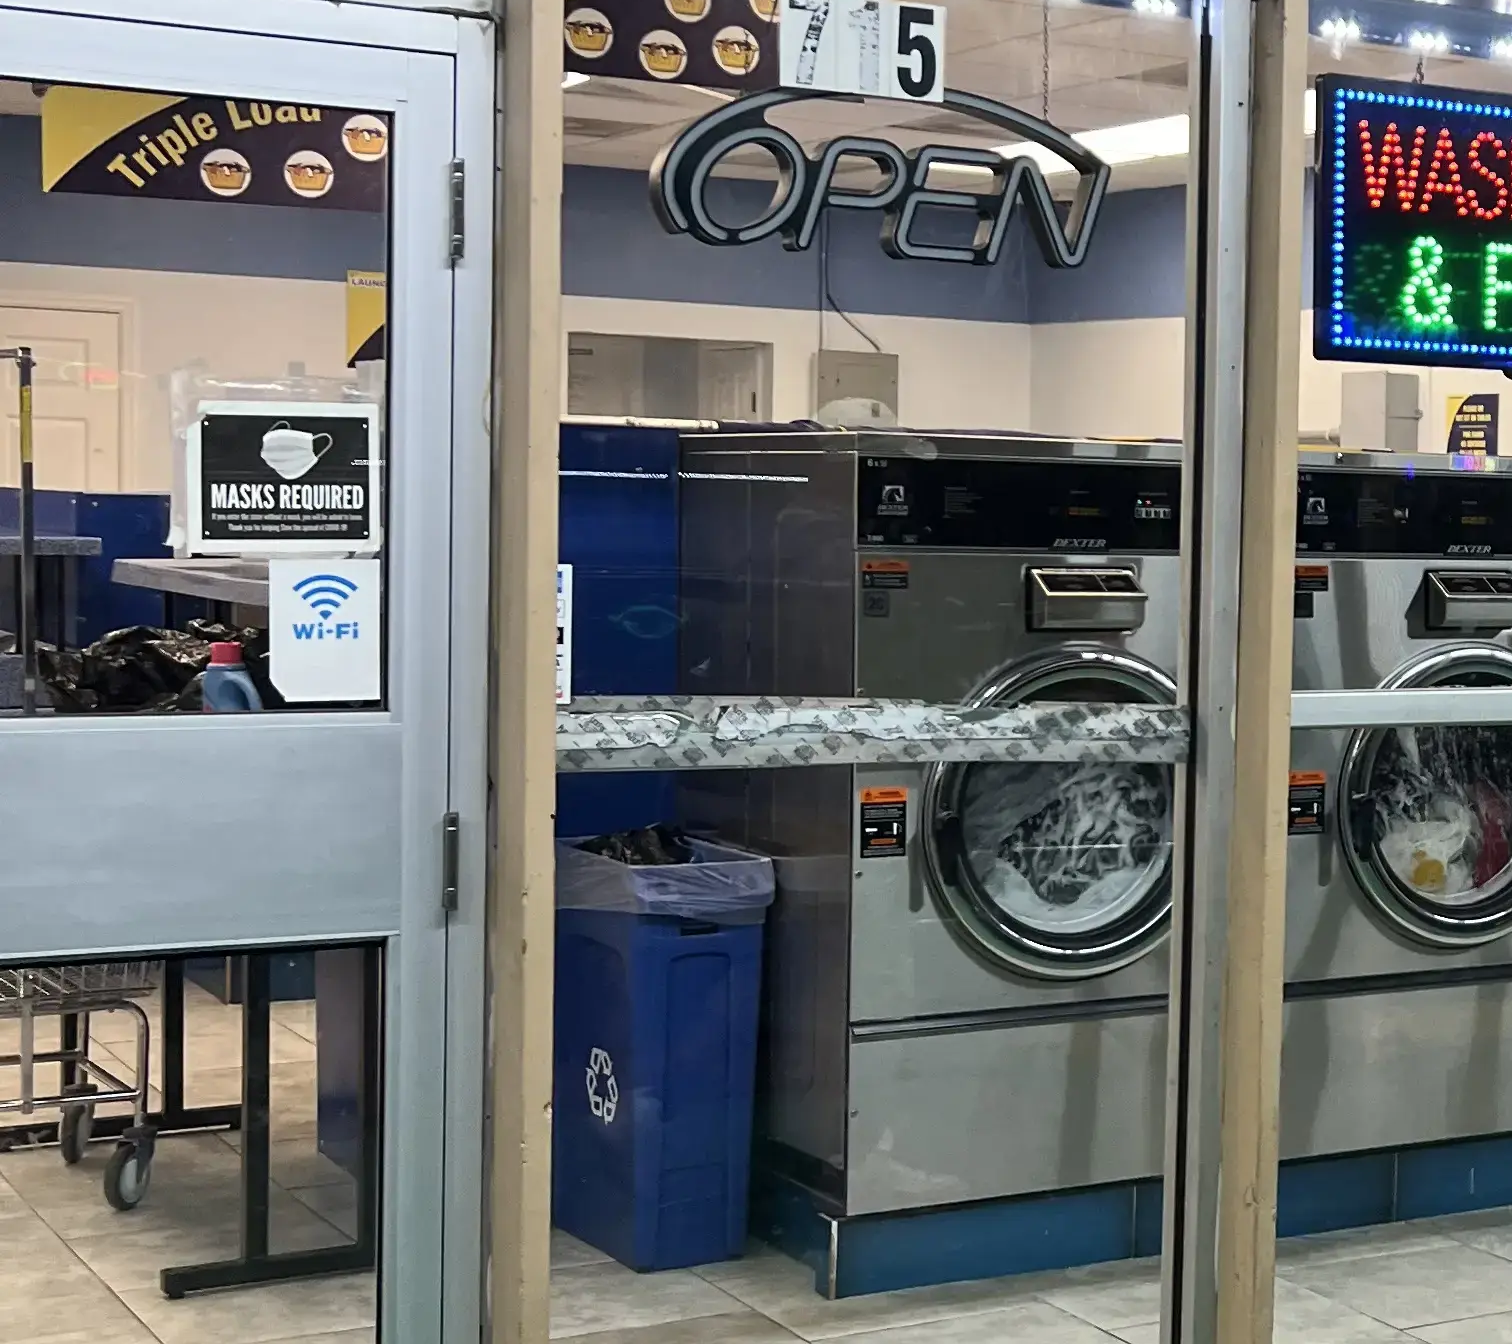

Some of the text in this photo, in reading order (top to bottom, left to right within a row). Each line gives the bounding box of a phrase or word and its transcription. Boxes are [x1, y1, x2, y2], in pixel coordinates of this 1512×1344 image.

[106, 112, 219, 188] Triple
[690, 124, 1111, 268] OPEN
[1402, 235, 1455, 326] &
[211, 483, 364, 510] MASKS REQUIRED
[1053, 538, 1107, 548] DEXTER
[1447, 544, 1492, 554] DEXTER
[292, 622, 359, 639] Wi-Fi
